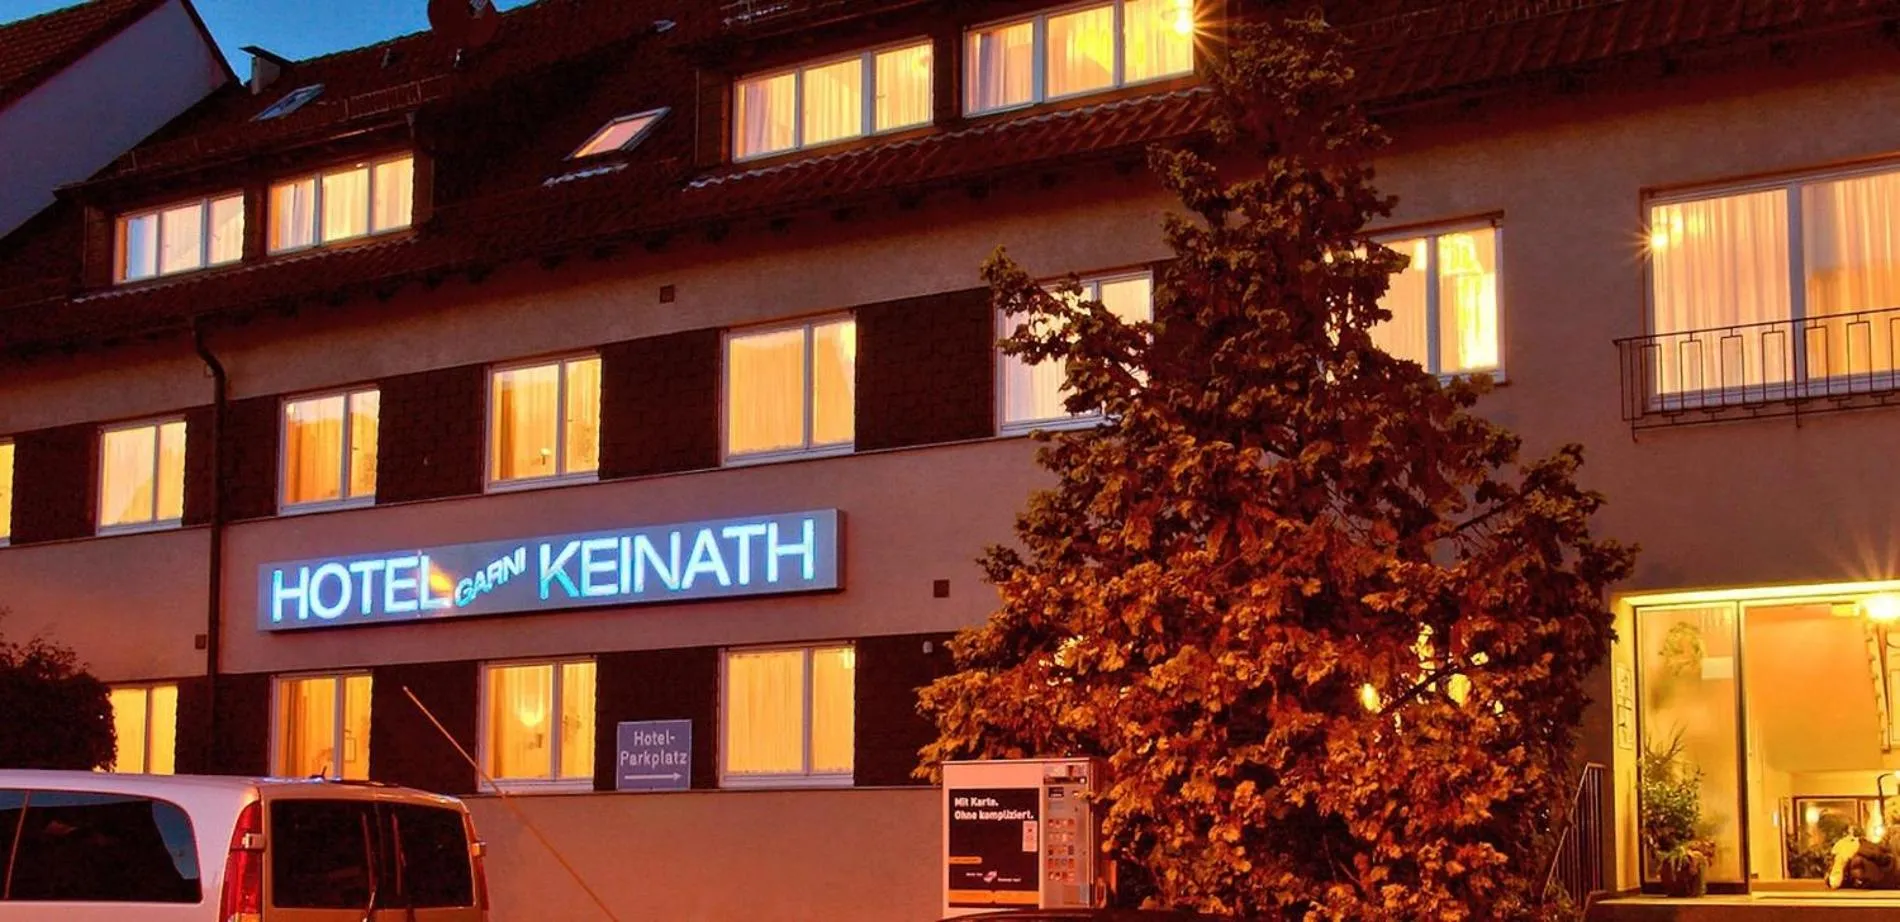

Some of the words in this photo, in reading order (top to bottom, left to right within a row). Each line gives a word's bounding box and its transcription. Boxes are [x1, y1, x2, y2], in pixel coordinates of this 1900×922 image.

[271, 554, 453, 623] HOTEL
[454, 546, 527, 608] GARNI
[538, 518, 815, 600] KEINATH
[633, 728, 676, 747] Hotel-
[620, 749, 688, 770] Parkplatz
[954, 797, 969, 807] Mit
[970, 797, 999, 807] Karte.
[954, 810, 978, 820] Ohne
[979, 809, 1034, 821] kompliziert.
